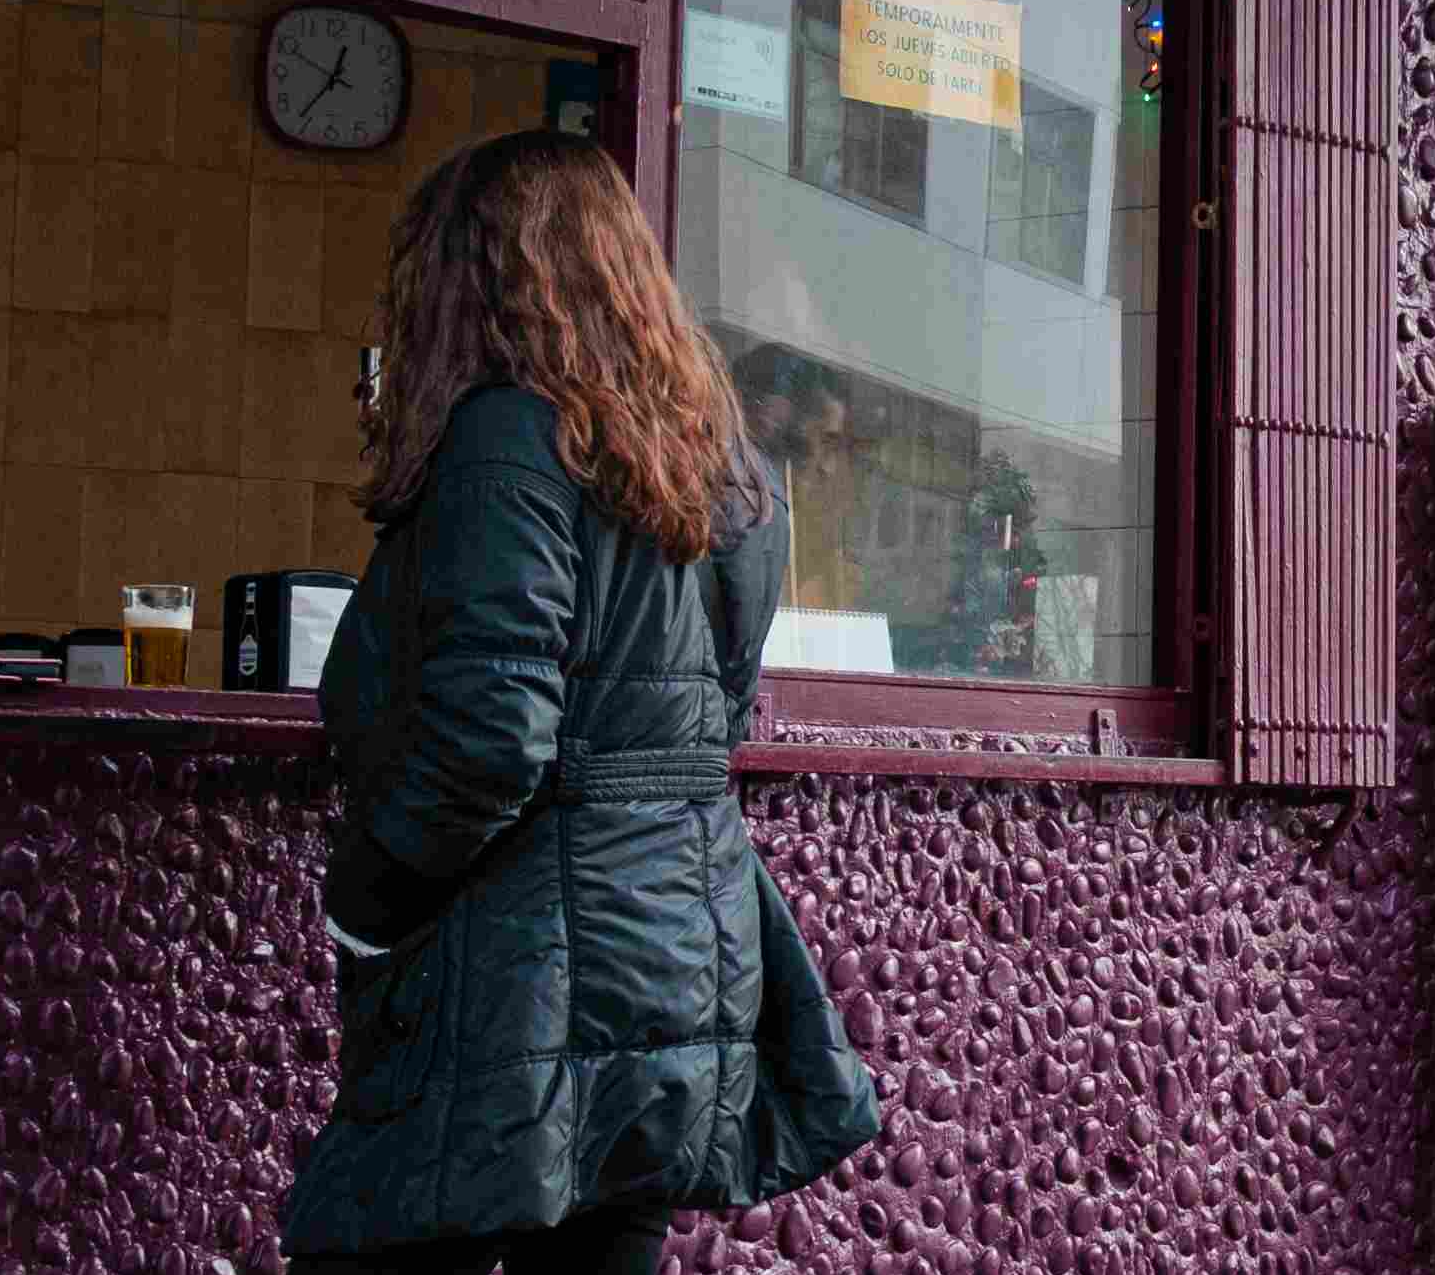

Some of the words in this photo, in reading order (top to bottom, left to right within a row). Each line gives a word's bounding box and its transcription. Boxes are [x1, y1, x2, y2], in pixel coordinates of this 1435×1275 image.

[859, 28, 888, 47] LOS
[894, 33, 947, 60] JUEVES
[876, 61, 915, 82] SOLO
[919, 68, 937, 86] DE
